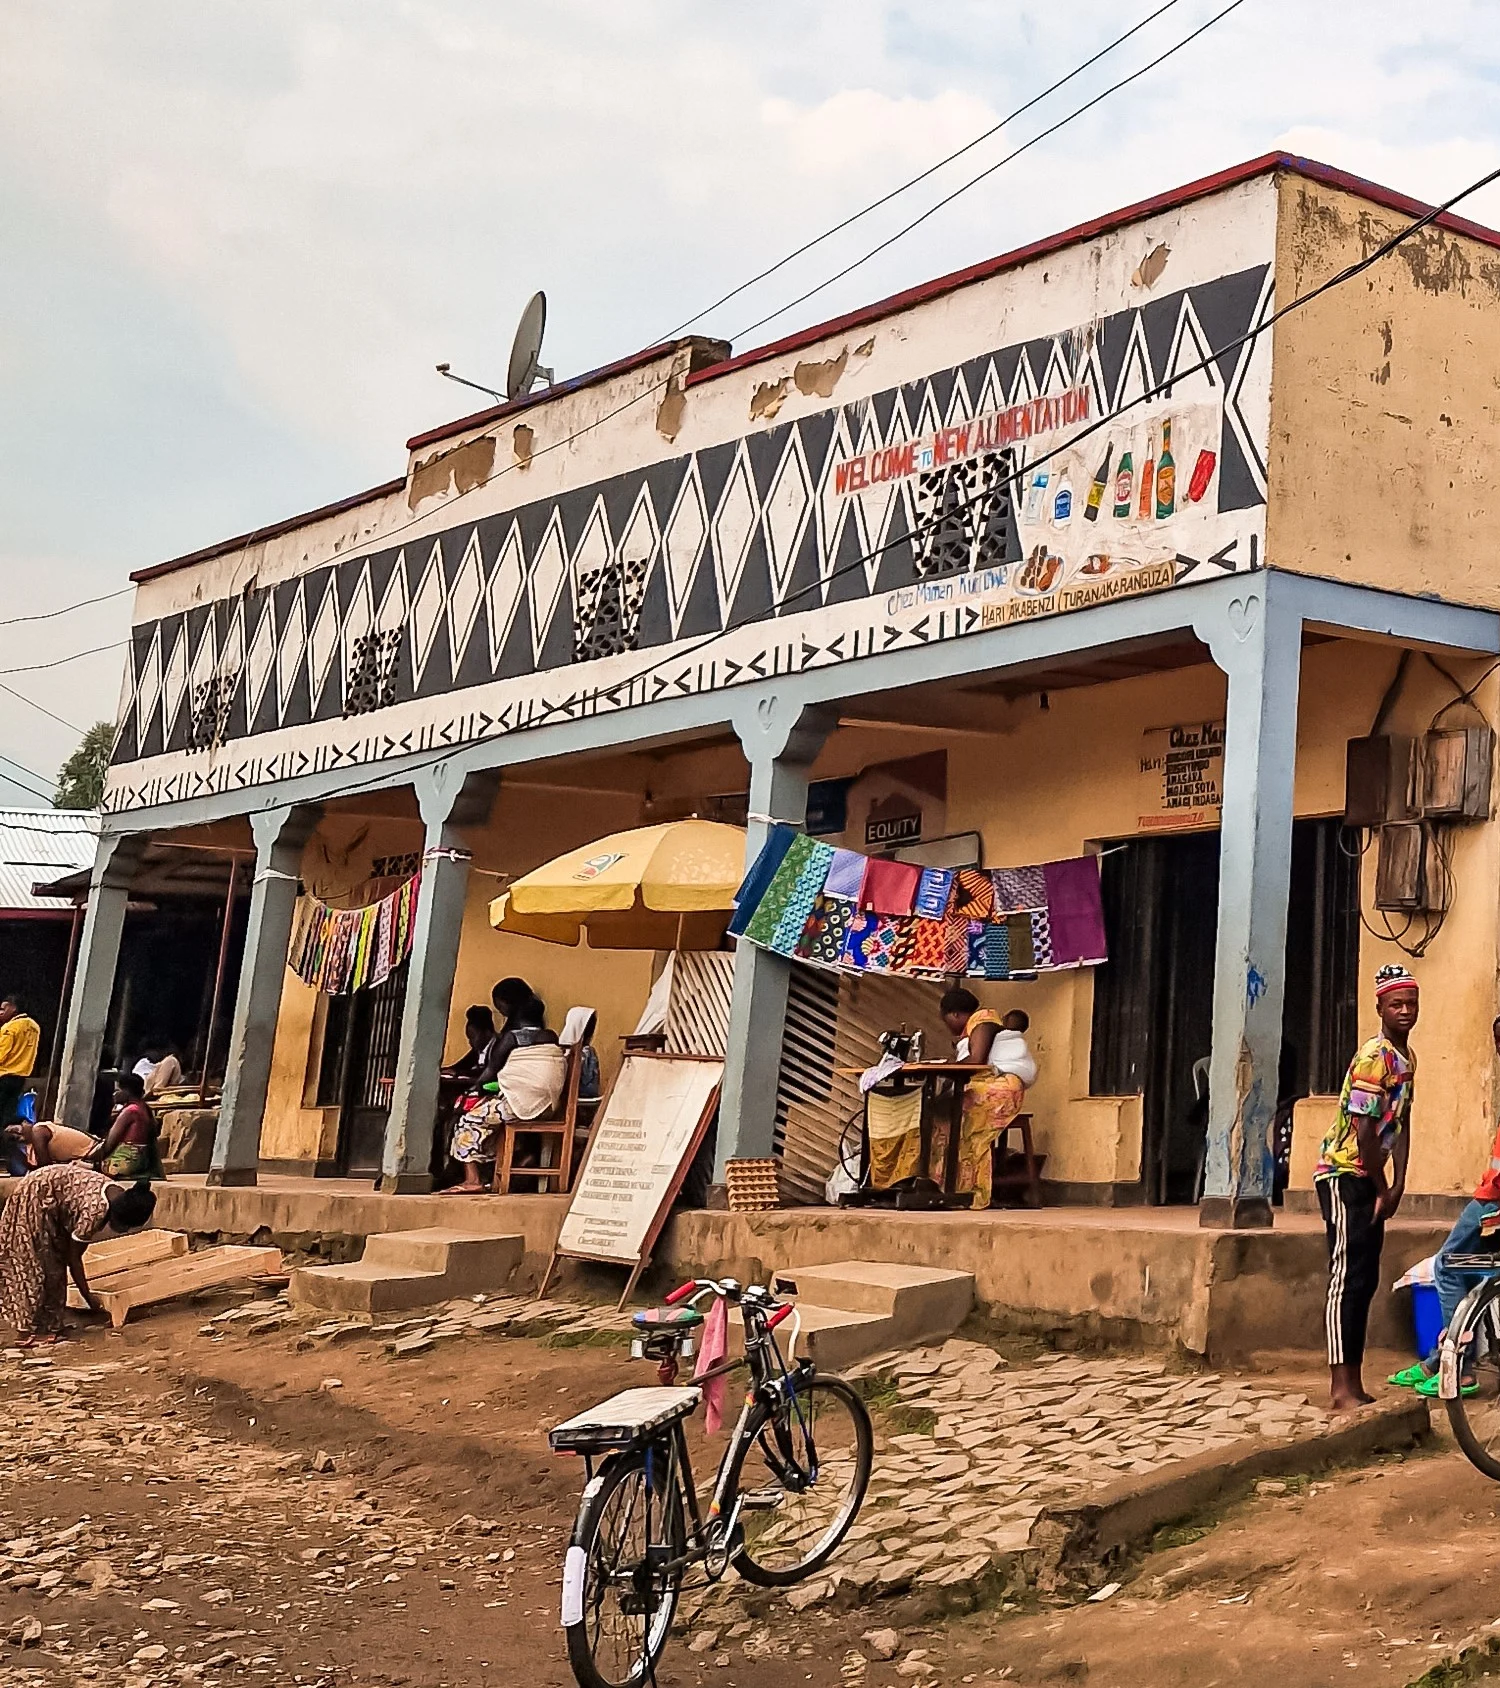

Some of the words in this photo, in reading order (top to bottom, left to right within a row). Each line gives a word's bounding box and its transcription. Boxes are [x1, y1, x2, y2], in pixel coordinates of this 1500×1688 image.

[835, 439, 920, 496] WELCOME
[932, 424, 971, 467] NEW
[981, 605, 1006, 628] HARI
[868, 815, 919, 841] EQUITY
